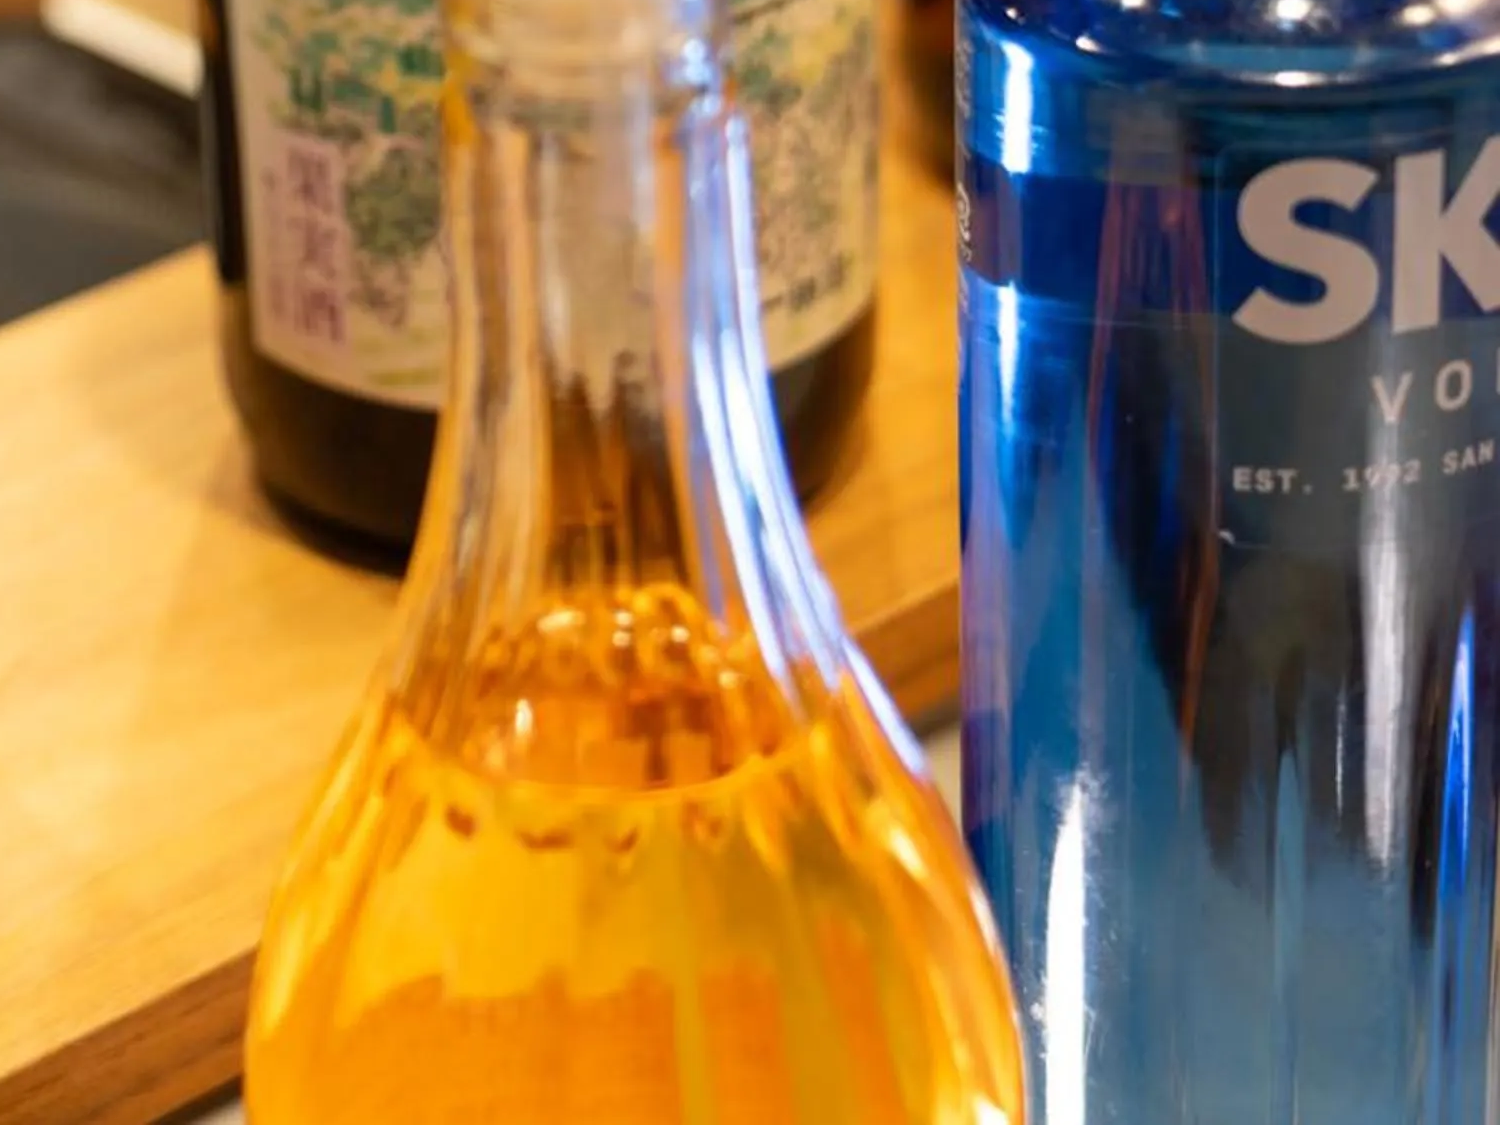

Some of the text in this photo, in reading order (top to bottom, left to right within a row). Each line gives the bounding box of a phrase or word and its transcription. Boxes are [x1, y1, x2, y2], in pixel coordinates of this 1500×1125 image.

[1371, 346, 1500, 424] VO
[1232, 465, 1313, 495] EST.
[1442, 439, 1495, 475] SAN
